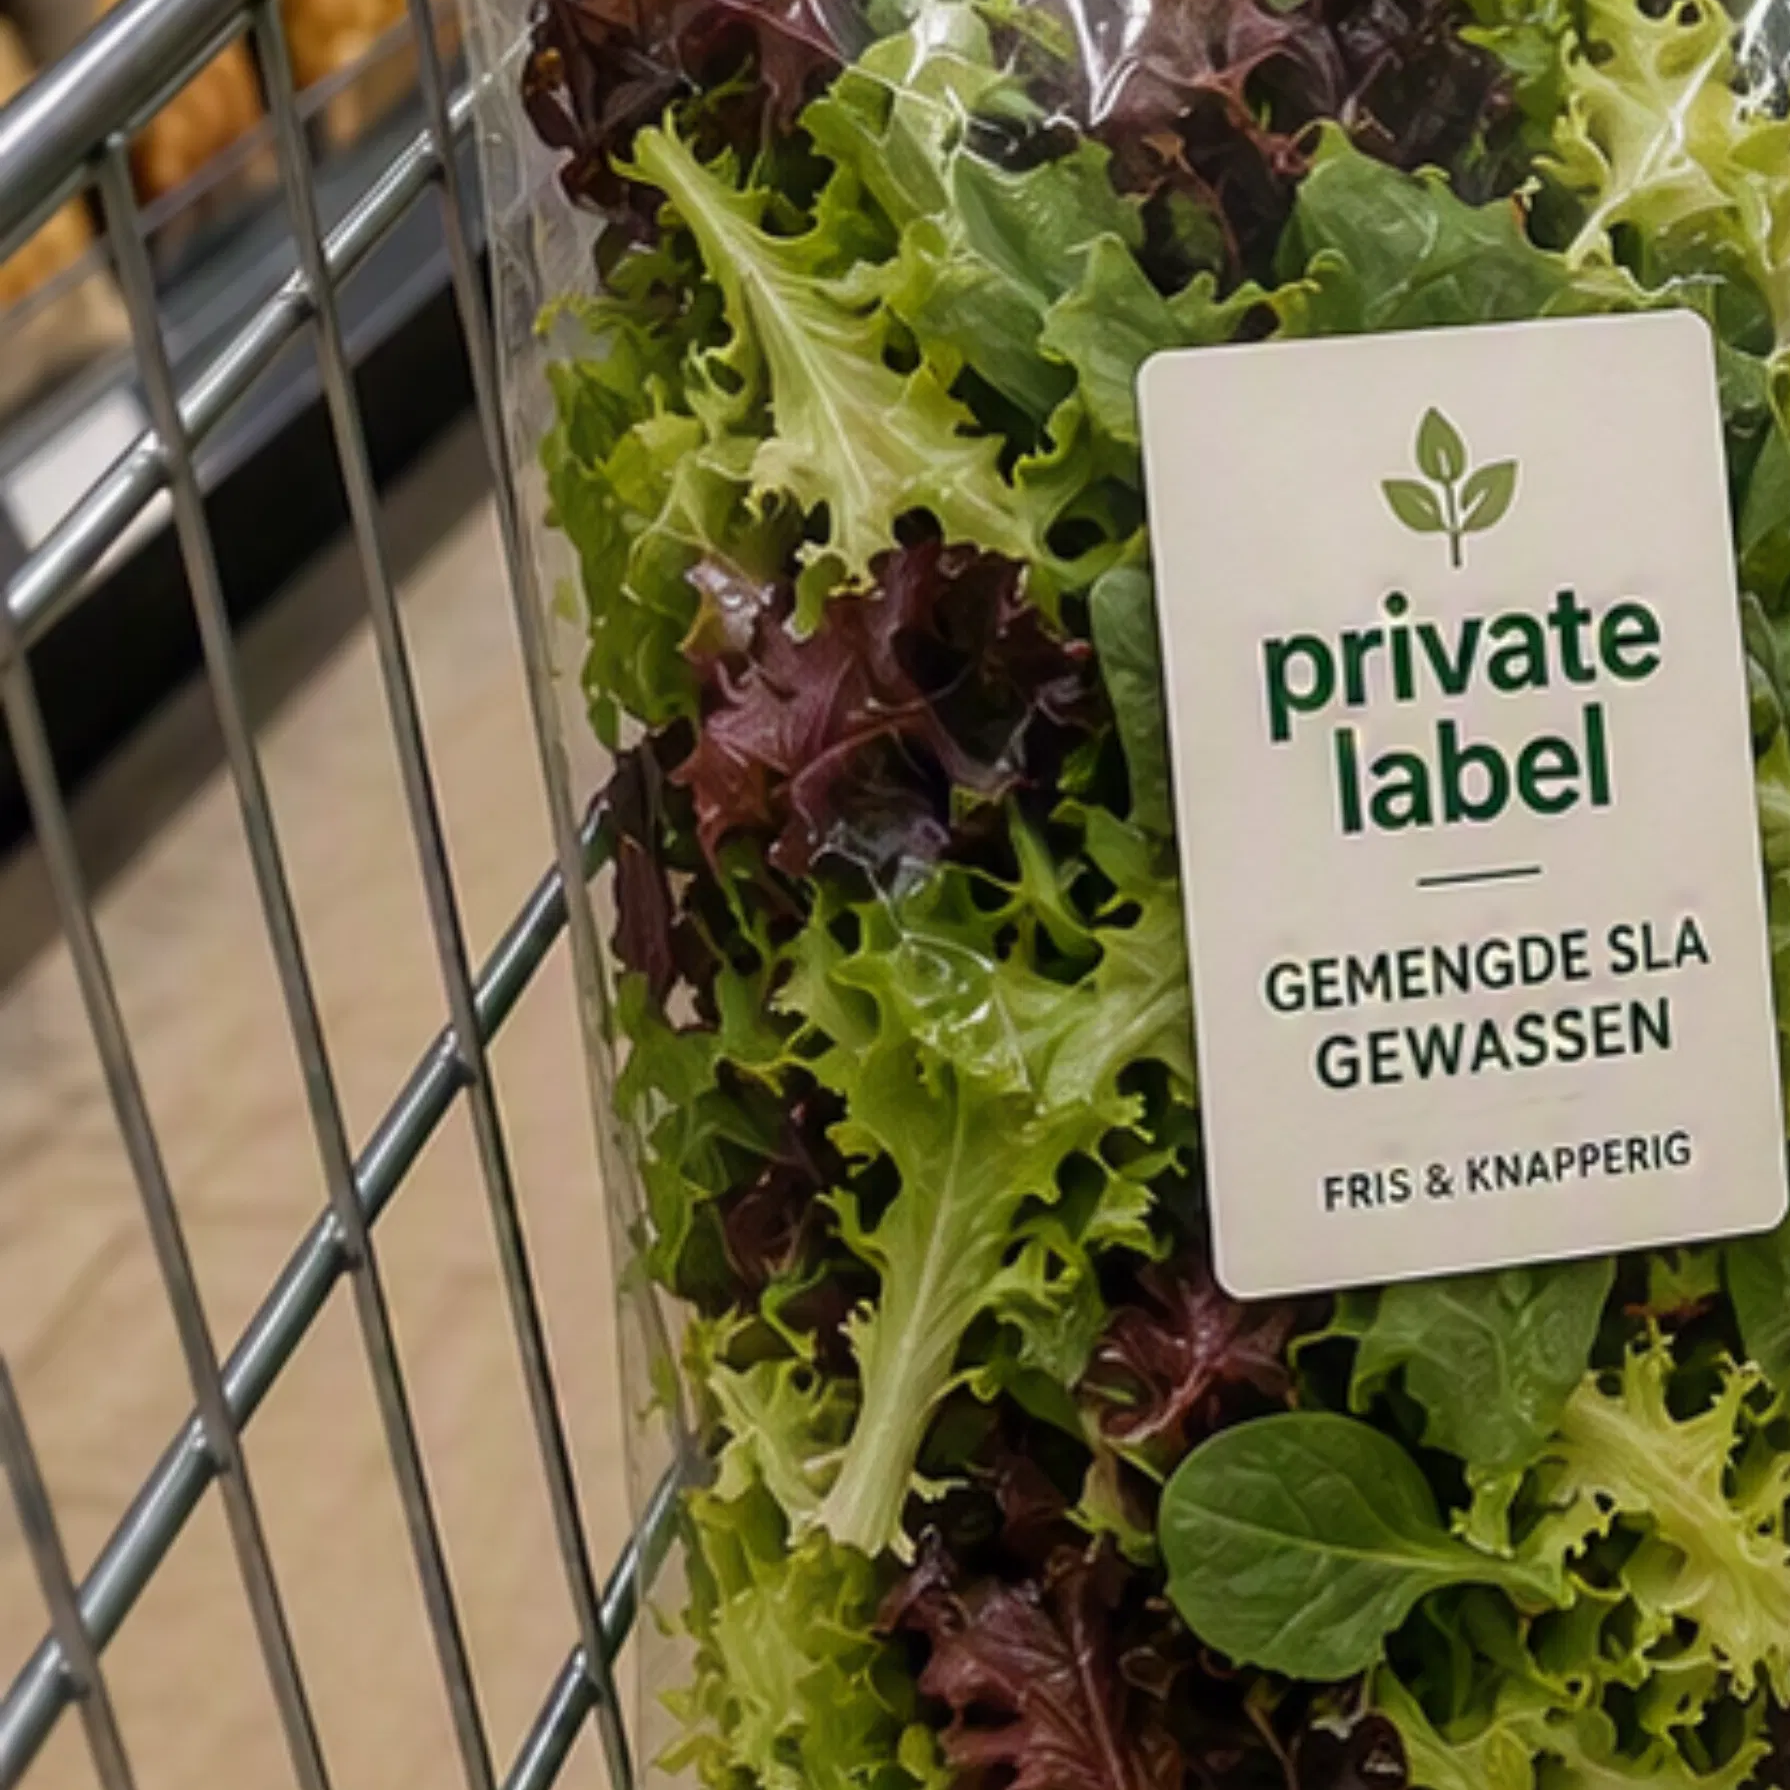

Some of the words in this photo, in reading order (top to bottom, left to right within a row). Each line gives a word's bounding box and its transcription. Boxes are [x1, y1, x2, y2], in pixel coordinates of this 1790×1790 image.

[1262, 589, 1661, 744] private
[1334, 701, 1611, 835] label
[1264, 928, 1592, 1013] GEMENGDE
[1607, 916, 1710, 976] SLA
[1315, 996, 1671, 1090] GEWASSEN
[1324, 1168, 1412, 1212] FRIS
[1425, 1163, 1454, 1199] &
[1466, 1130, 1691, 1193] KNAPPERIG
